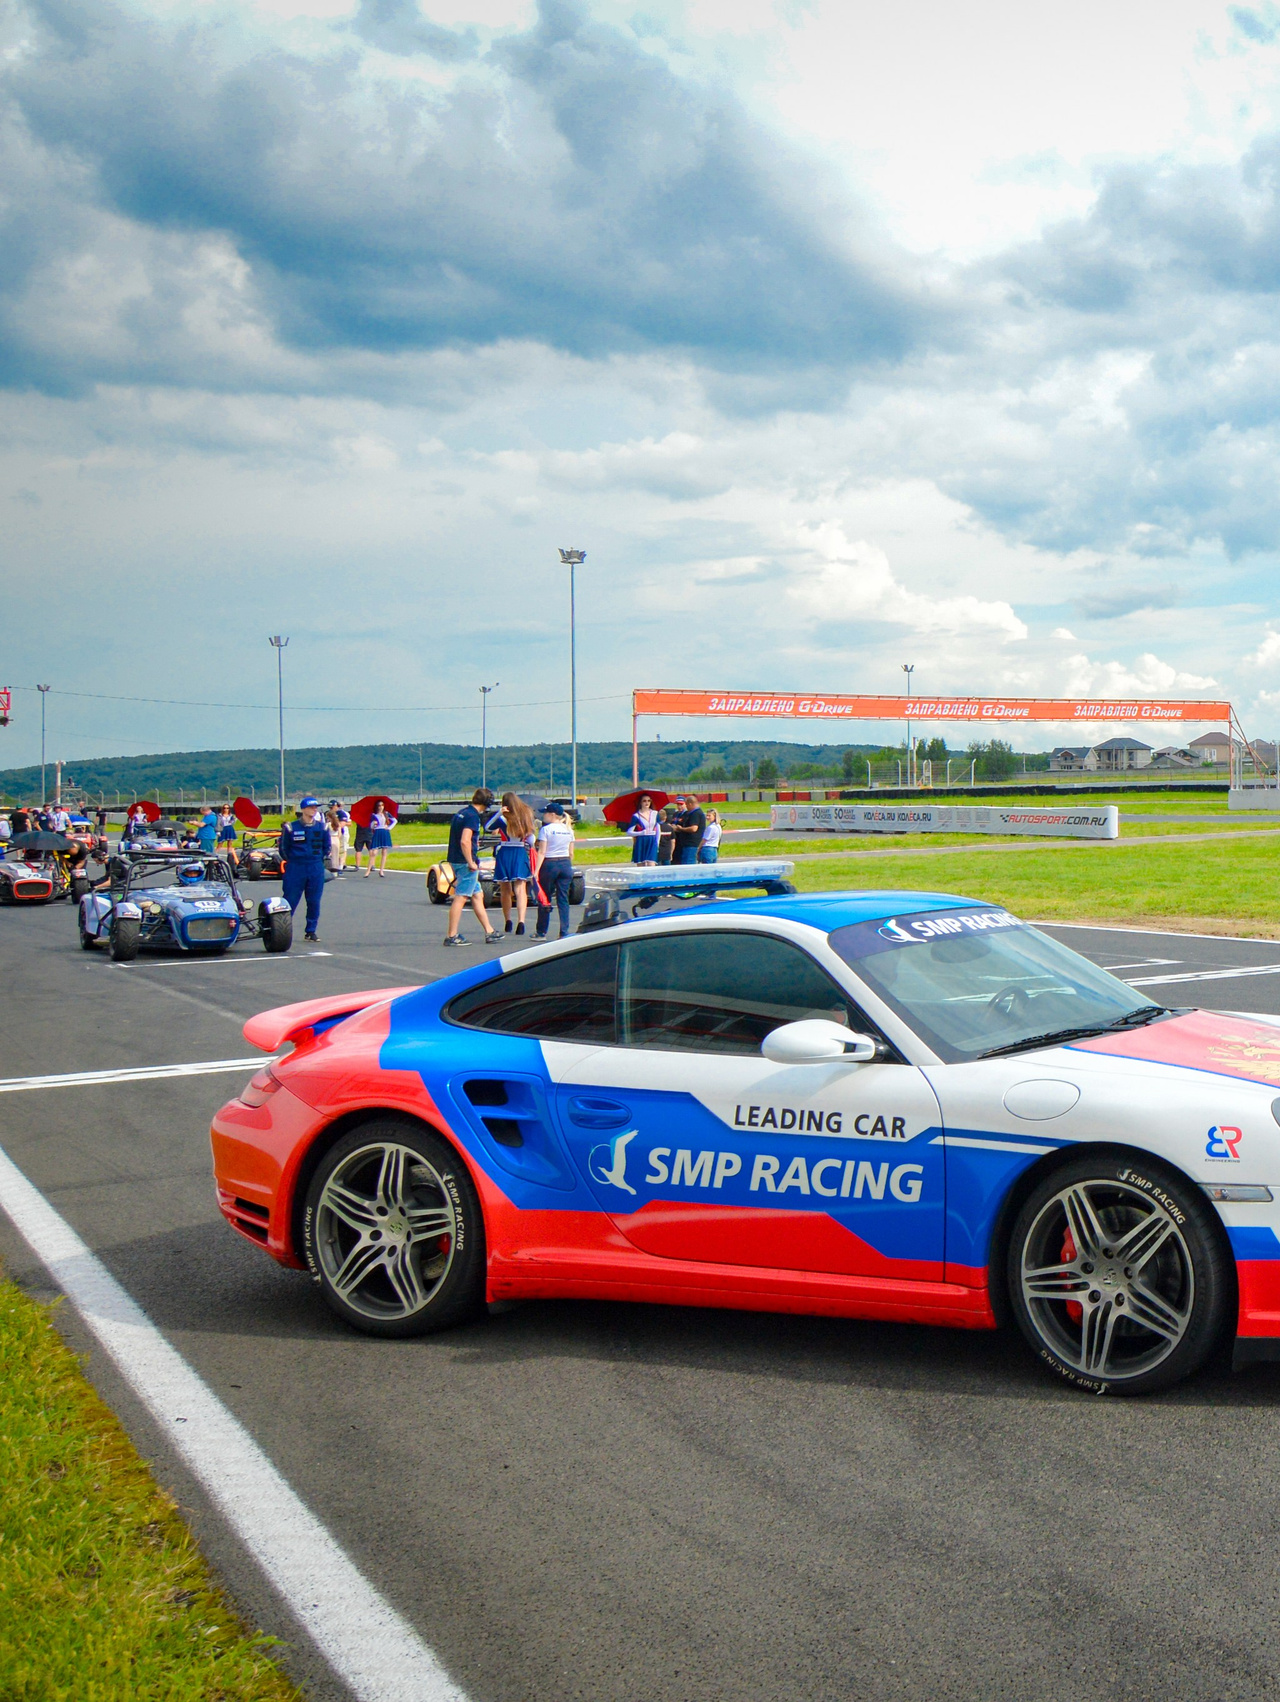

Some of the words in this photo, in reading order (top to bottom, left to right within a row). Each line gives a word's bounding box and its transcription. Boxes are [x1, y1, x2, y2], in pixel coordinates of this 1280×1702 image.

[708, 698, 794, 712] ЗАПРАВЛЕНО
[905, 703, 978, 716] ЗАПРАВЛЕНО
[1074, 705, 1138, 717] ЗАПРАВЛЕНО
[1008, 814, 1107, 826] AUTOSPORT.COM.RU
[911, 919, 962, 937] SMP
[734, 1105, 842, 1133] LEADING
[854, 1114, 906, 1138] CAR
[645, 1147, 743, 1190] SMP
[749, 1155, 924, 1203] RACING
[1129, 1174, 1153, 1191] SMP
[1152, 1187, 1187, 1225] RACING
[304, 1205, 313, 1249] RACING
[447, 1181, 461, 1205] SMP
[454, 1206, 465, 1251] RACING
[305, 1249, 318, 1274] SMP
[1040, 1349, 1076, 1378] RACING
[1077, 1376, 1100, 1390] SMP
